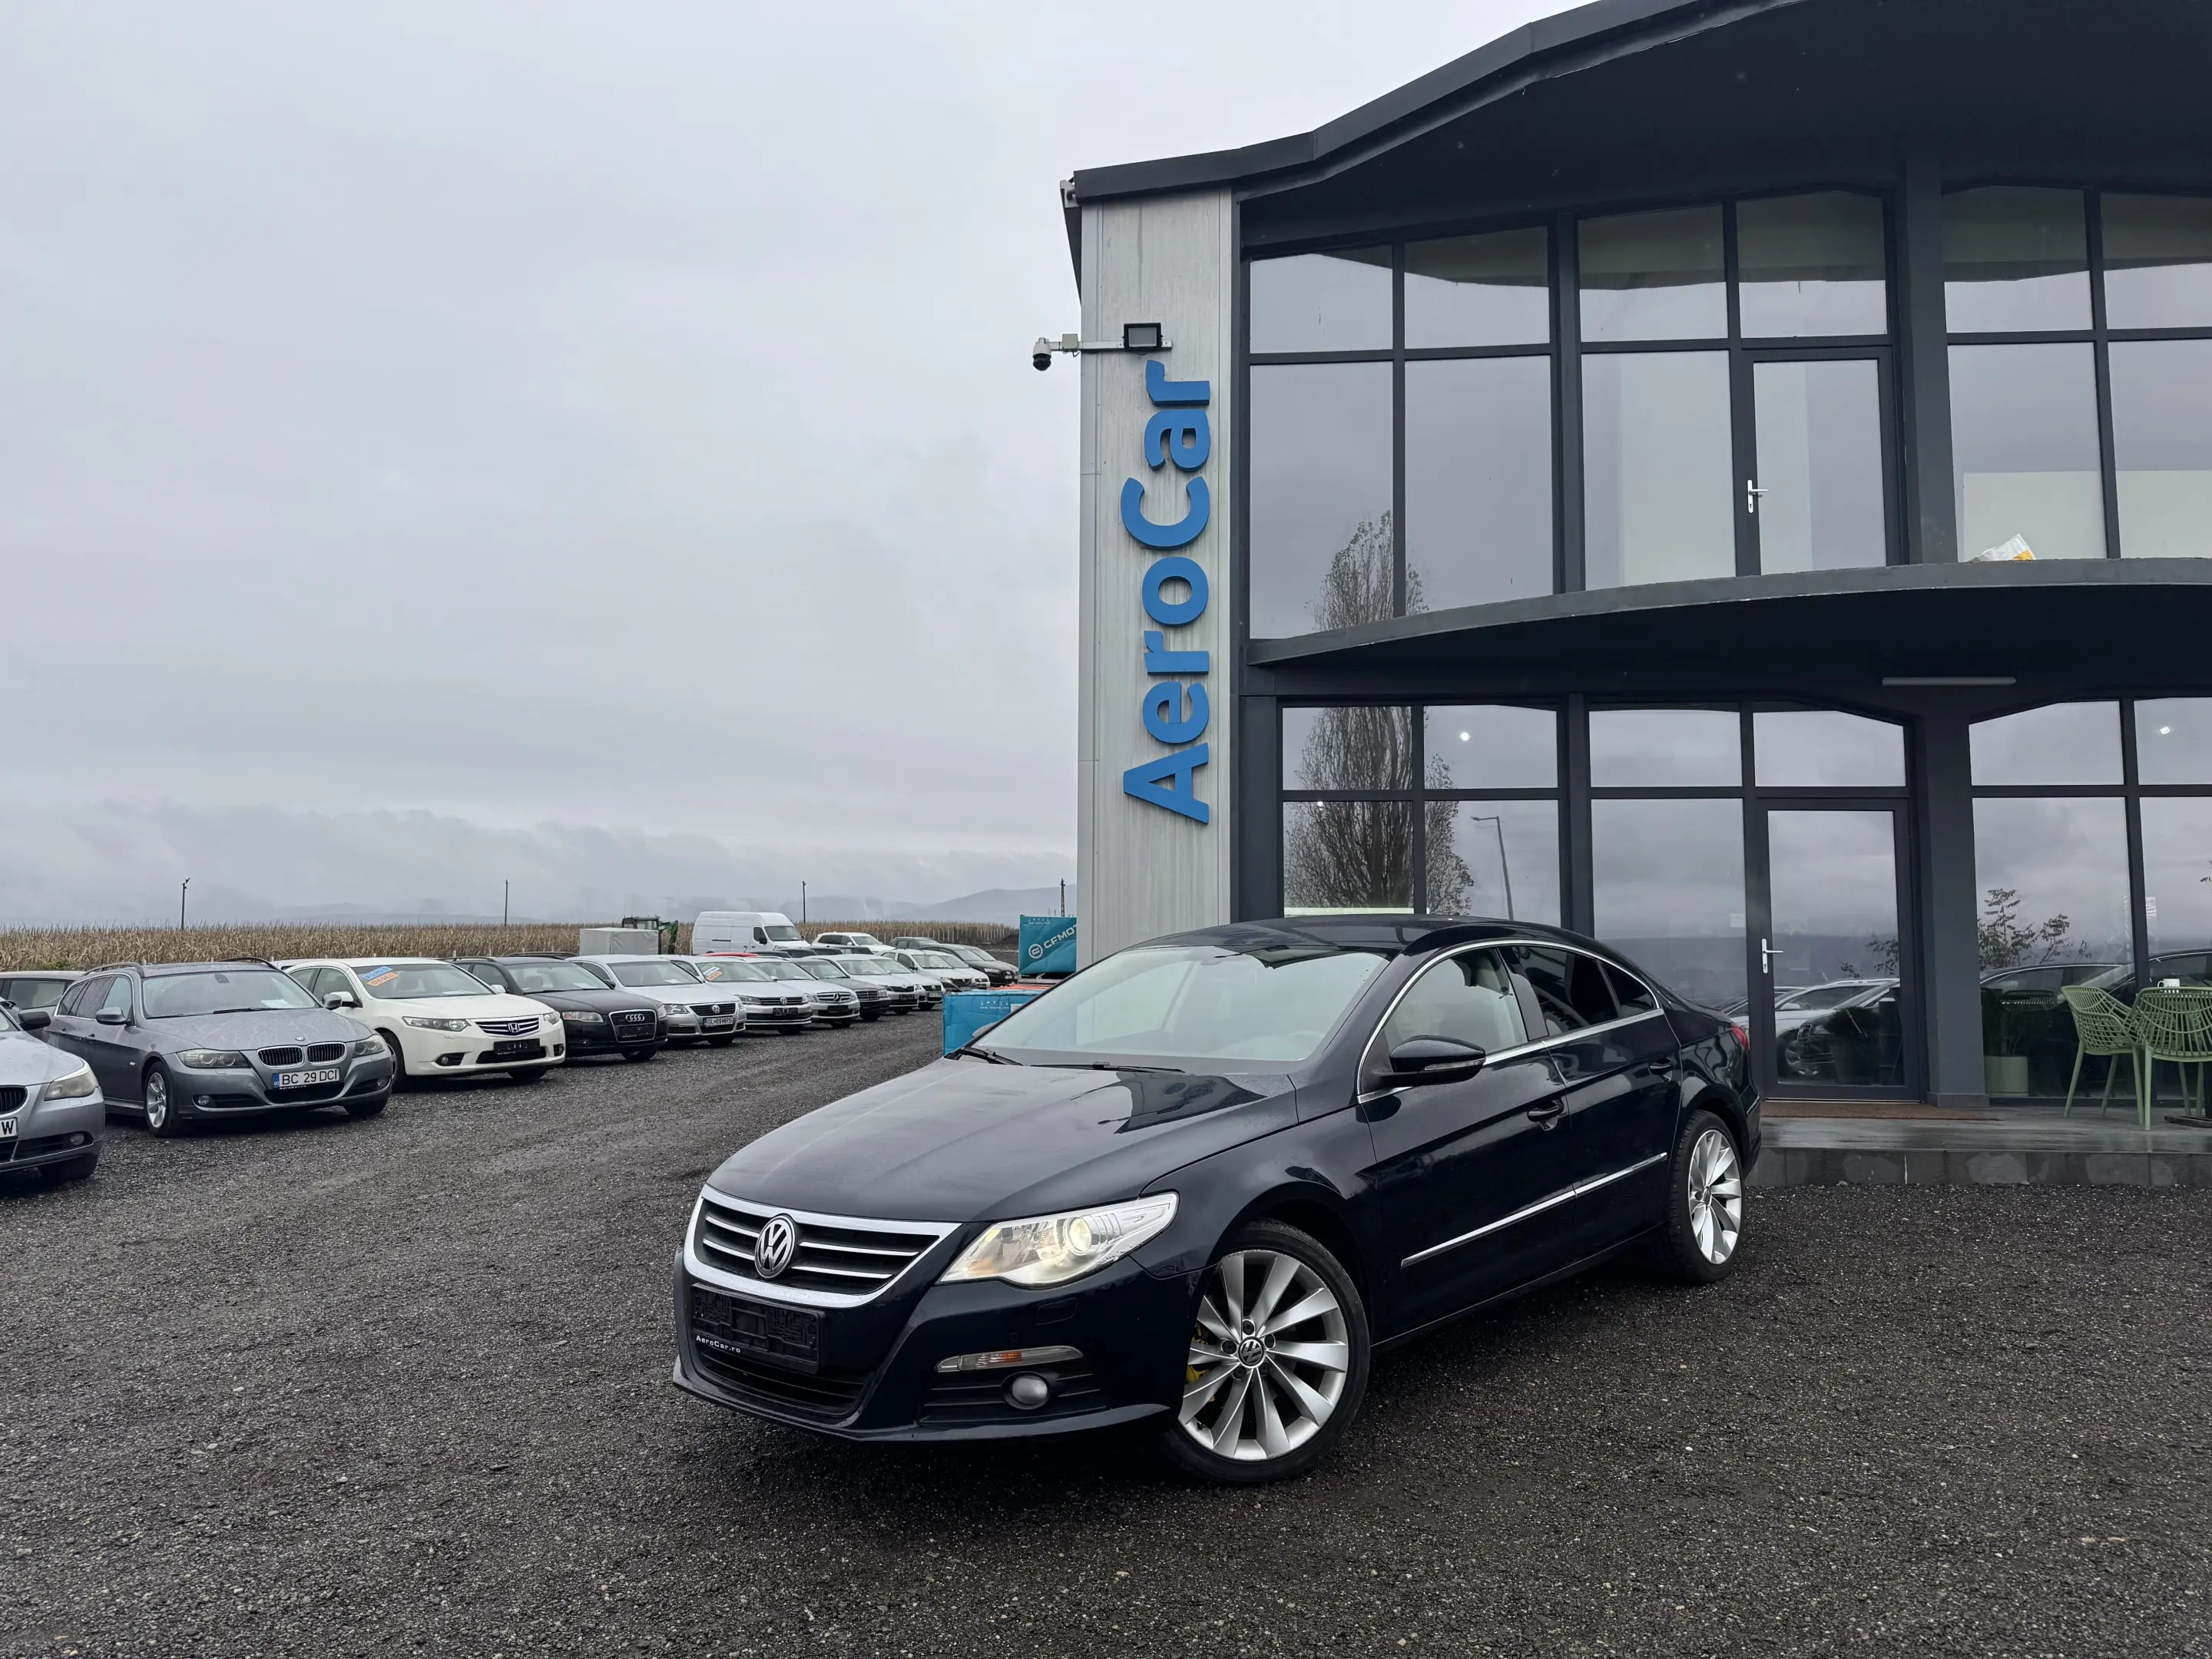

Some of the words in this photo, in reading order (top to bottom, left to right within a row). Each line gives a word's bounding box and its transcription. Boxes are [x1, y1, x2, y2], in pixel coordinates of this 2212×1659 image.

[1120, 359, 1210, 824] AeroCar
[282, 1074, 299, 1085] BC
[303, 1072, 316, 1083] 29
[320, 1069, 337, 1081] DCI
[1, 1120, 14, 1135] W
[757, 1216, 795, 1277] VW
[696, 1335, 741, 1353] AeroCar.ro
[1240, 1338, 1265, 1367] VW
